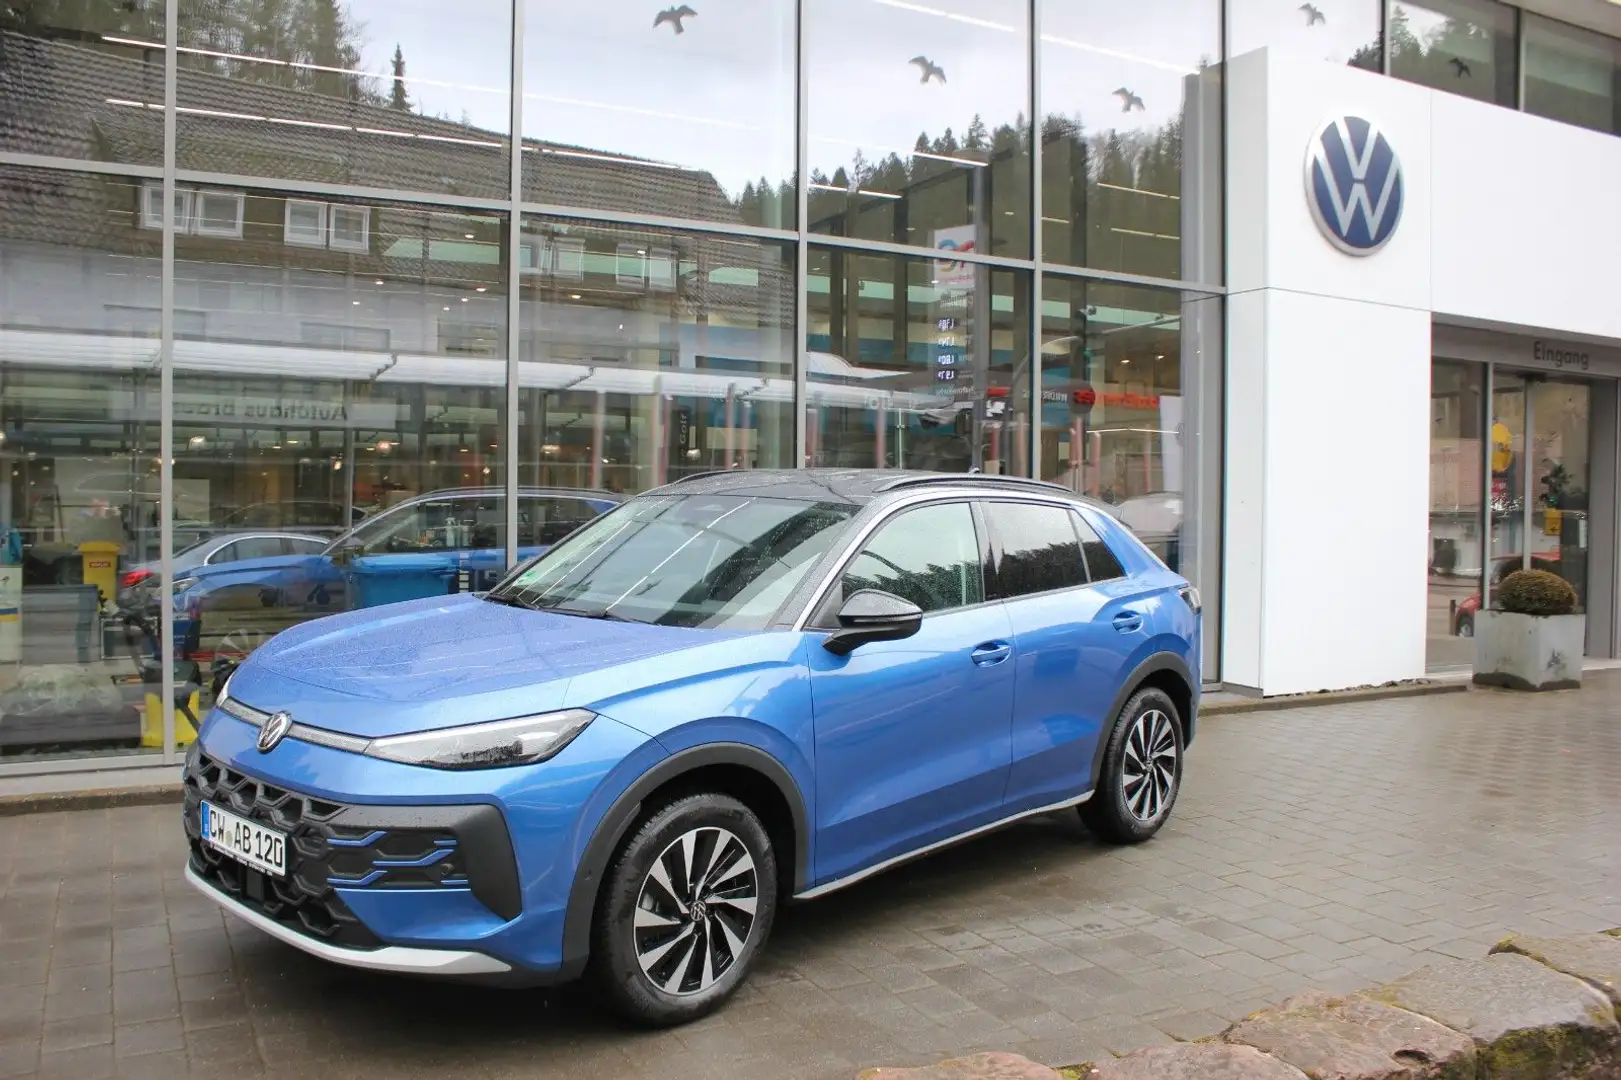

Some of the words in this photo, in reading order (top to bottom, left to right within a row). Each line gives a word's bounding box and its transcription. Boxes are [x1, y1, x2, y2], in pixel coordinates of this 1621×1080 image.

[1533, 340, 1590, 371] Eingang
[209, 809, 226, 843] CW
[233, 821, 252, 855] AB
[254, 830, 283, 868] 120
